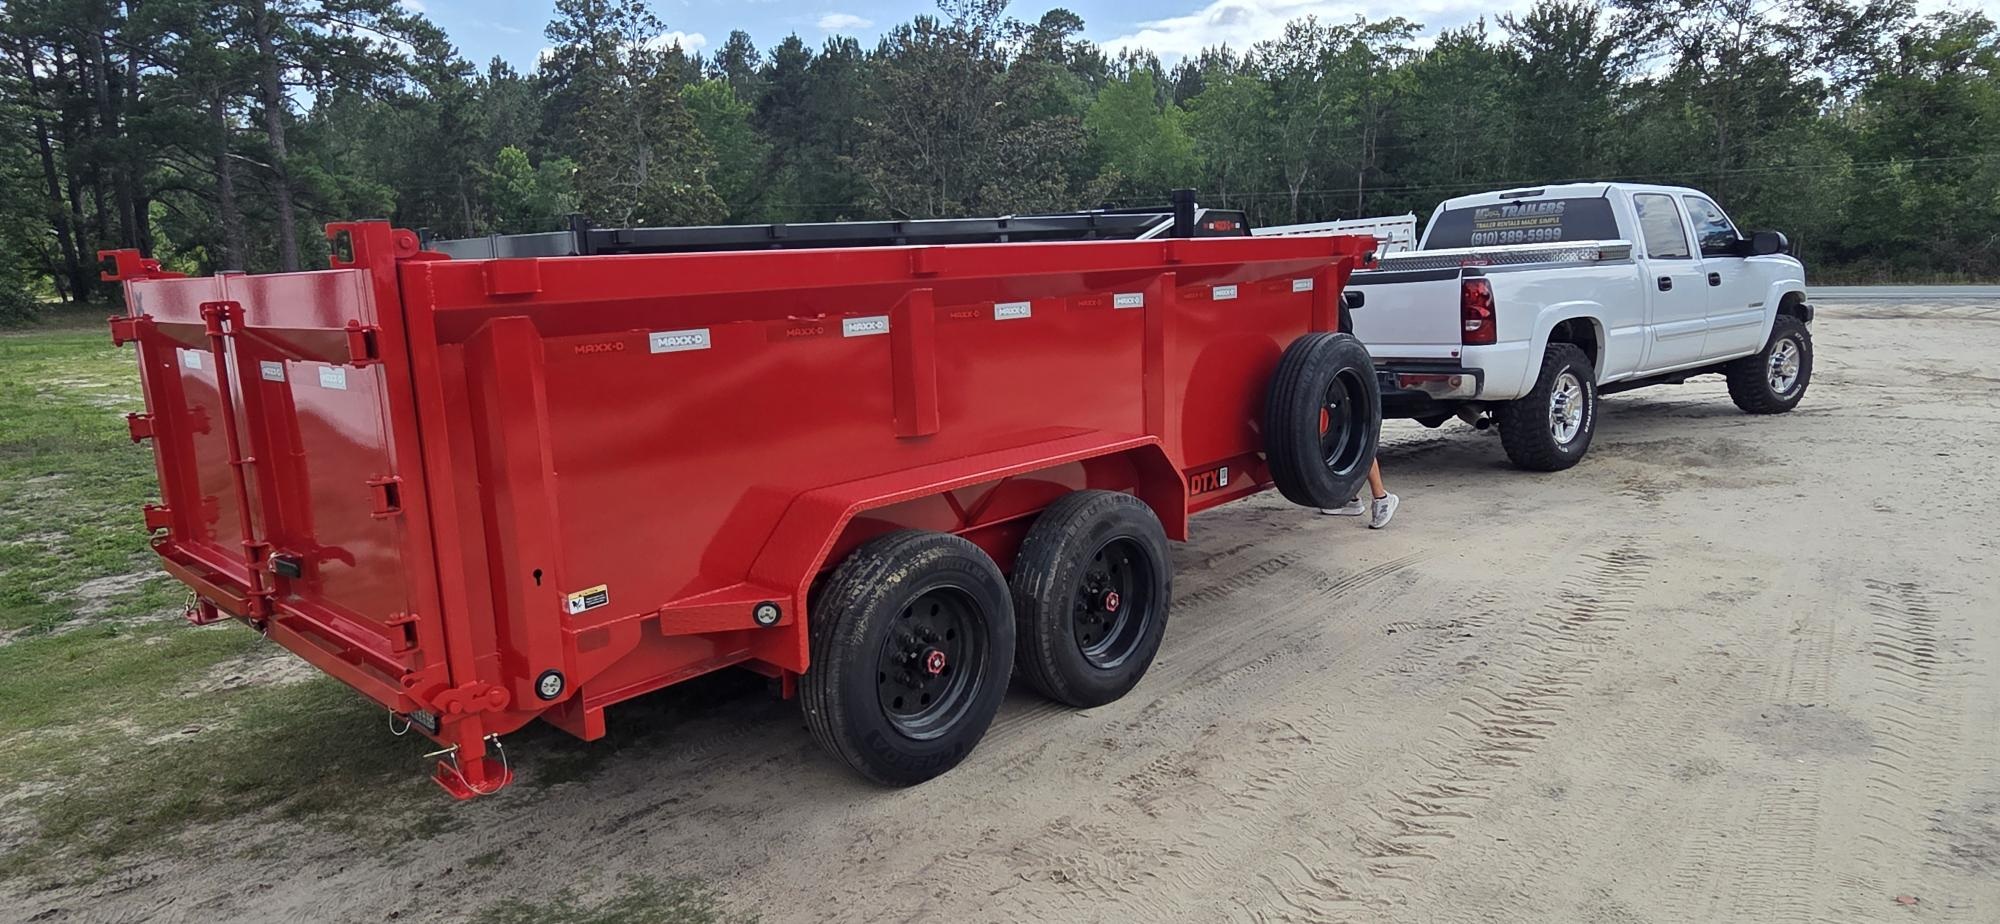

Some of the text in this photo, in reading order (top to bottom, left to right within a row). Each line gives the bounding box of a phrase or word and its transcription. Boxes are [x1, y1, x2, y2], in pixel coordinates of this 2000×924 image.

[1502, 201, 1566, 218] TRAILERS
[1476, 221, 1496, 229] TRAILER
[1496, 219, 1520, 228] RENTALS
[1538, 217, 1560, 225] SIMPLE
[1471, 227, 1562, 246] (910) 389-5999
[657, 333, 704, 348] MAXX-D
[1191, 469, 1220, 495] DTX
